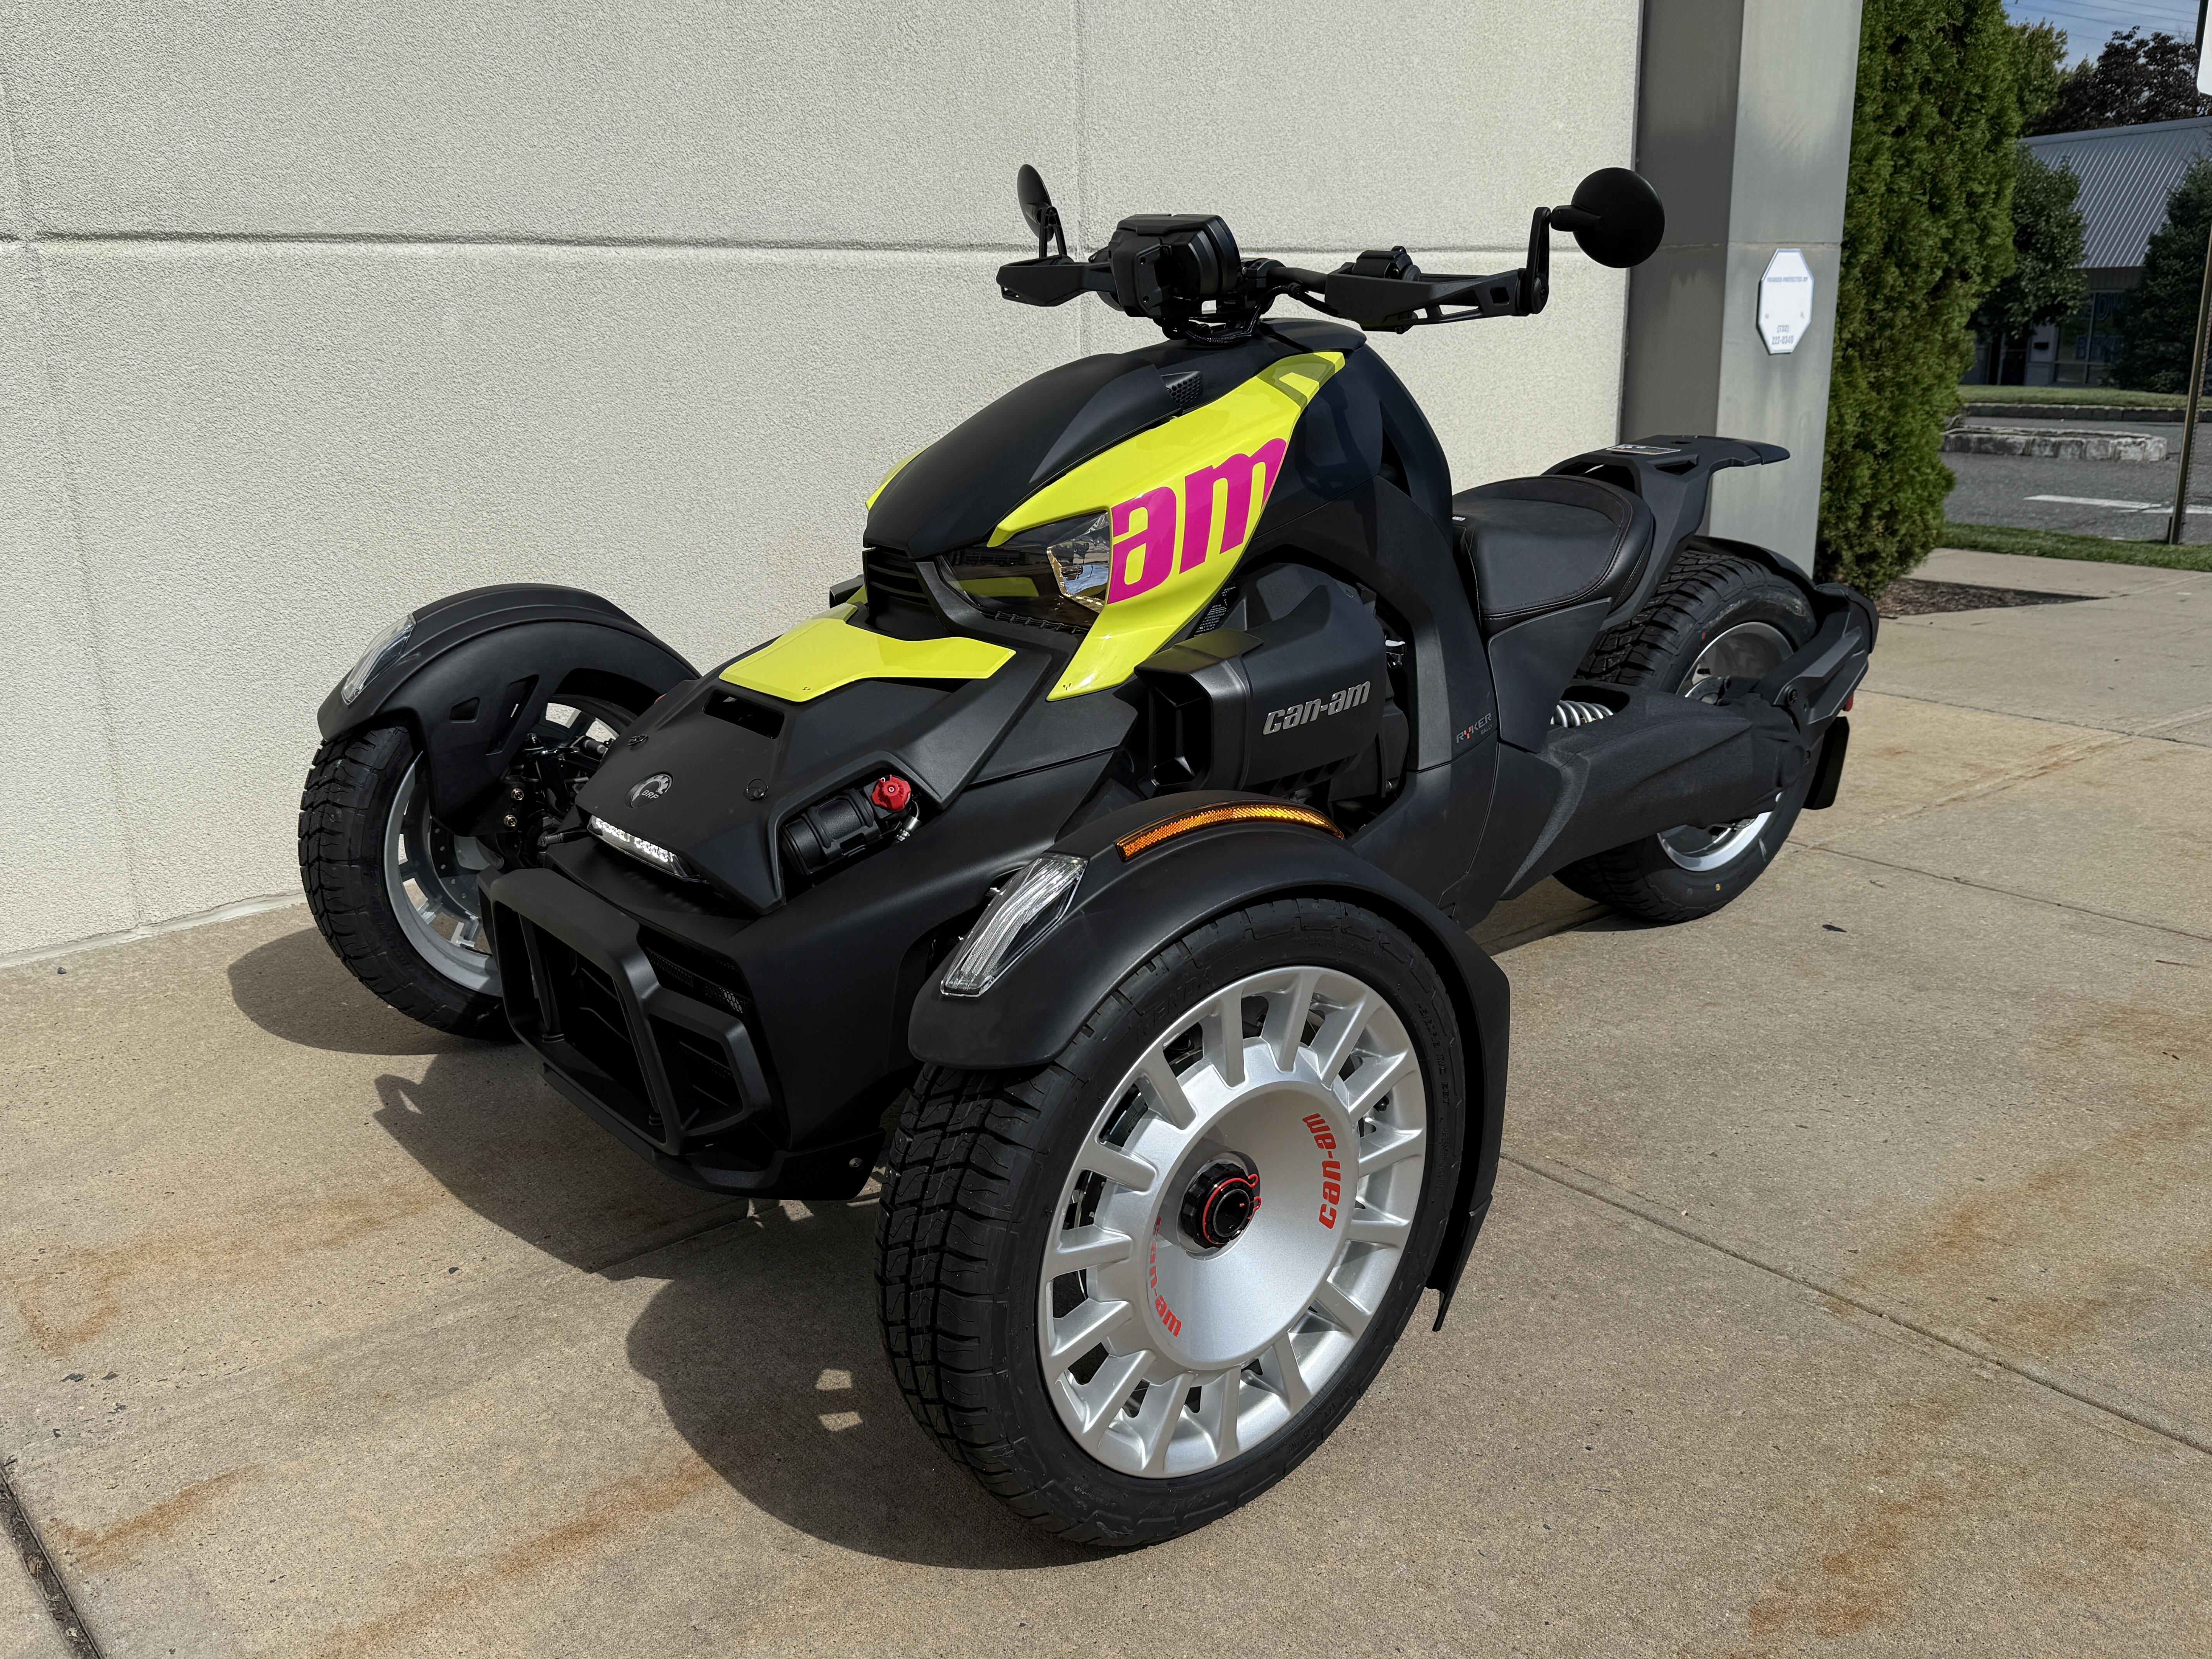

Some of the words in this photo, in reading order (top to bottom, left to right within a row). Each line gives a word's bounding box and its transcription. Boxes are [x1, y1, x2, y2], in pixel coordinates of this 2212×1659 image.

[1106, 438, 1286, 605] am
[1262, 680, 1371, 735] can-am
[1456, 712, 1492, 744] RYKER
[1480, 725, 1492, 735] RALLY
[641, 790, 659, 799] BRP
[1302, 1113, 1341, 1230] can-am
